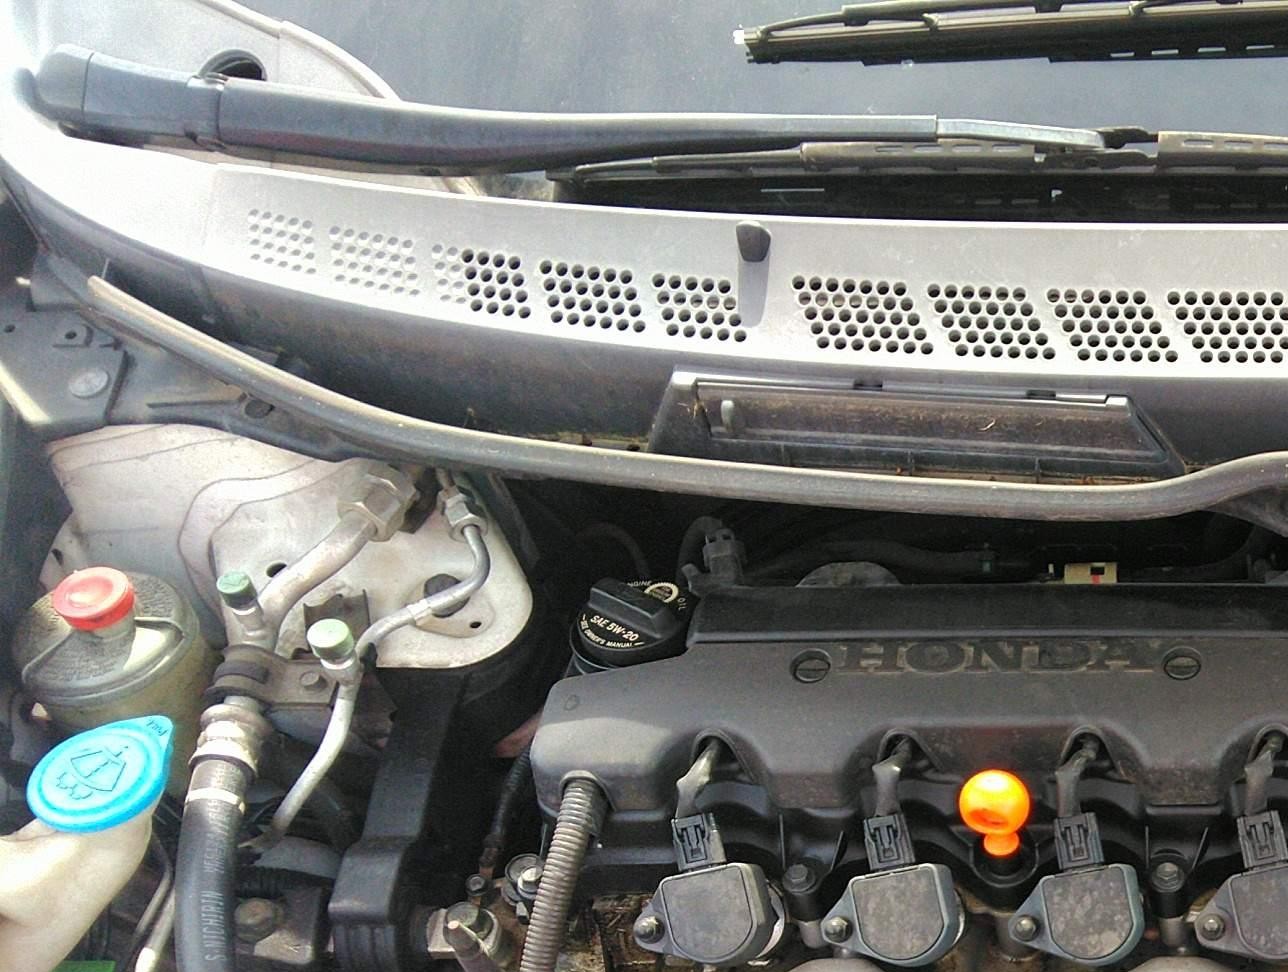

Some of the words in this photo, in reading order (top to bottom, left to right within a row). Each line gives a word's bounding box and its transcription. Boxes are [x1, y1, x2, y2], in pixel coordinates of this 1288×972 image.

[590, 614, 610, 628] SAE
[606, 620, 640, 641] 5W-20
[842, 639, 1155, 674] HONDA
